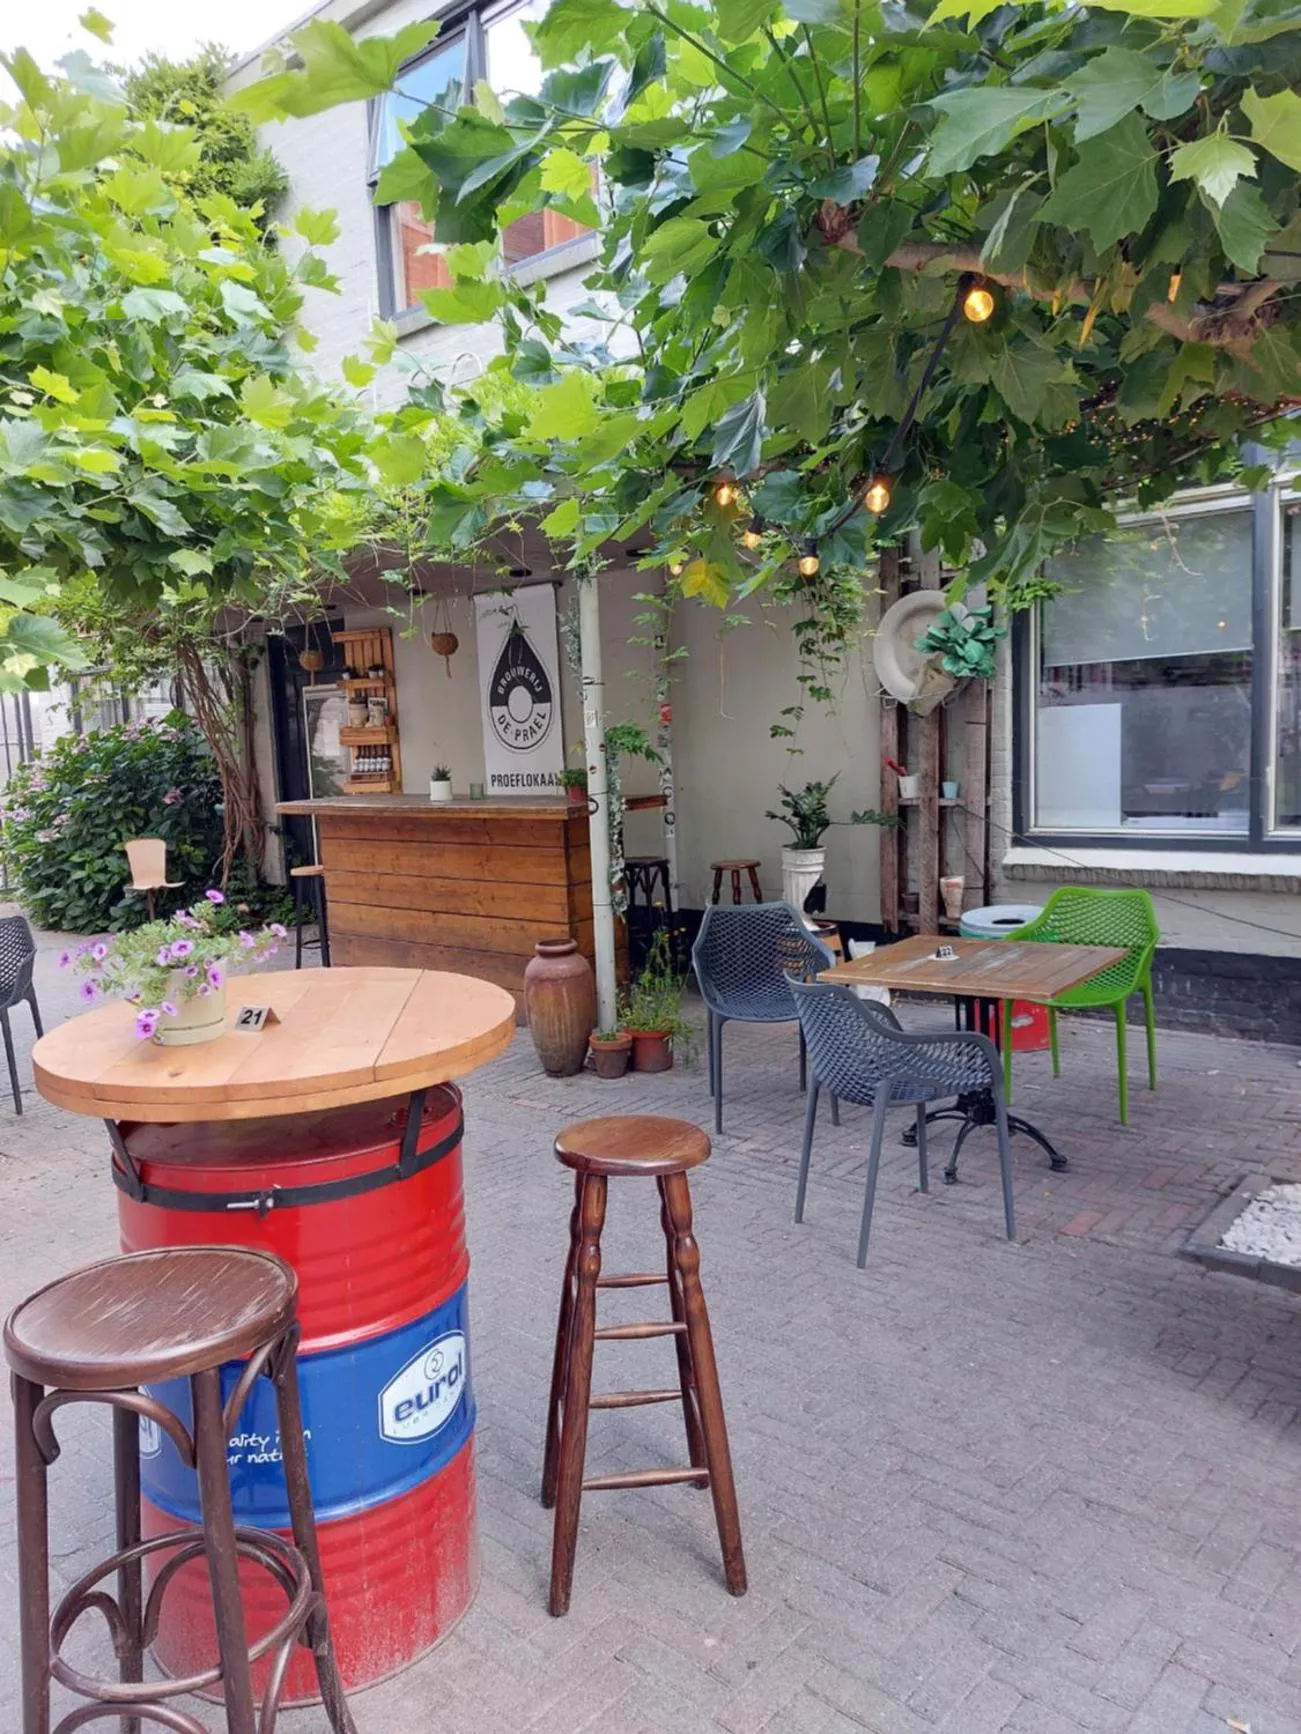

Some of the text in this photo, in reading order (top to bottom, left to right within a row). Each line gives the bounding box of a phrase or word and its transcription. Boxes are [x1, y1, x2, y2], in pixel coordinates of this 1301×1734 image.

[497, 666, 543, 695] BROUWERIJ
[498, 712, 546, 741] DE PRAEL
[240, 1009, 263, 1025] 21
[395, 1352, 462, 1422] eurol
[229, 1433, 270, 1452] ality
[247, 1449, 284, 1463] nat
